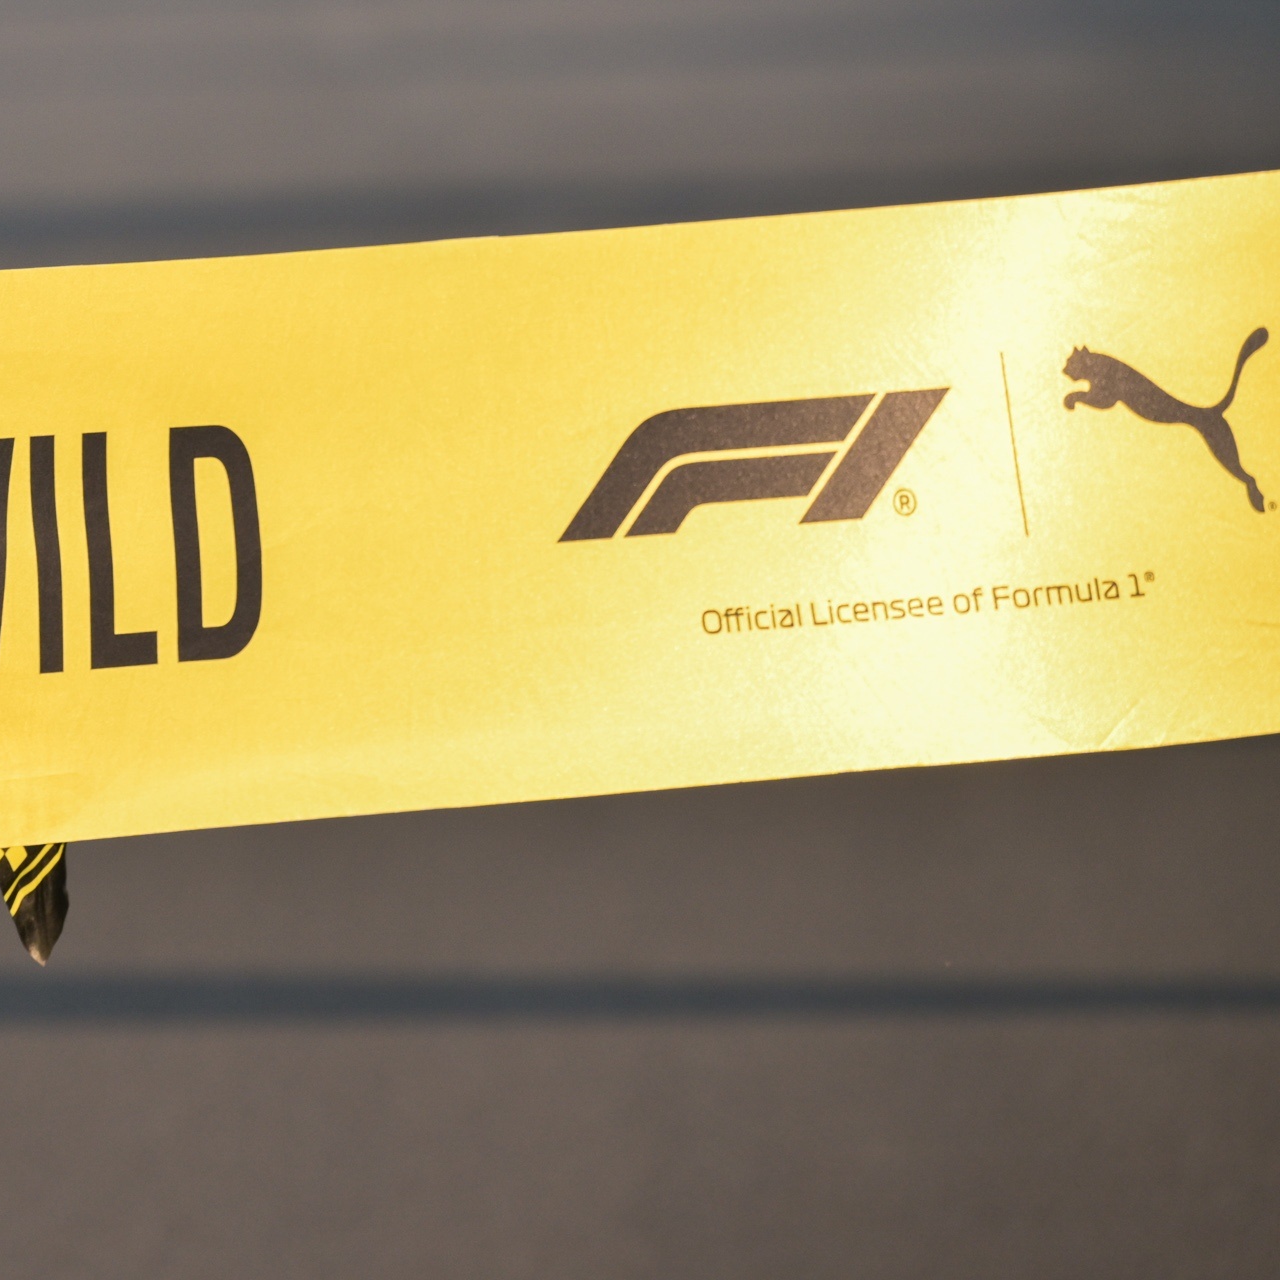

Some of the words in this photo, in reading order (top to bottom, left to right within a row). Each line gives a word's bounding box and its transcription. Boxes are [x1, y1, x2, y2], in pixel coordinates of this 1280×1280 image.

[557, 387, 951, 543] F1
[701, 603, 803, 635] Official
[810, 596, 944, 627] Licensee
[952, 587, 983, 614] of
[991, 577, 1122, 610] Formula
